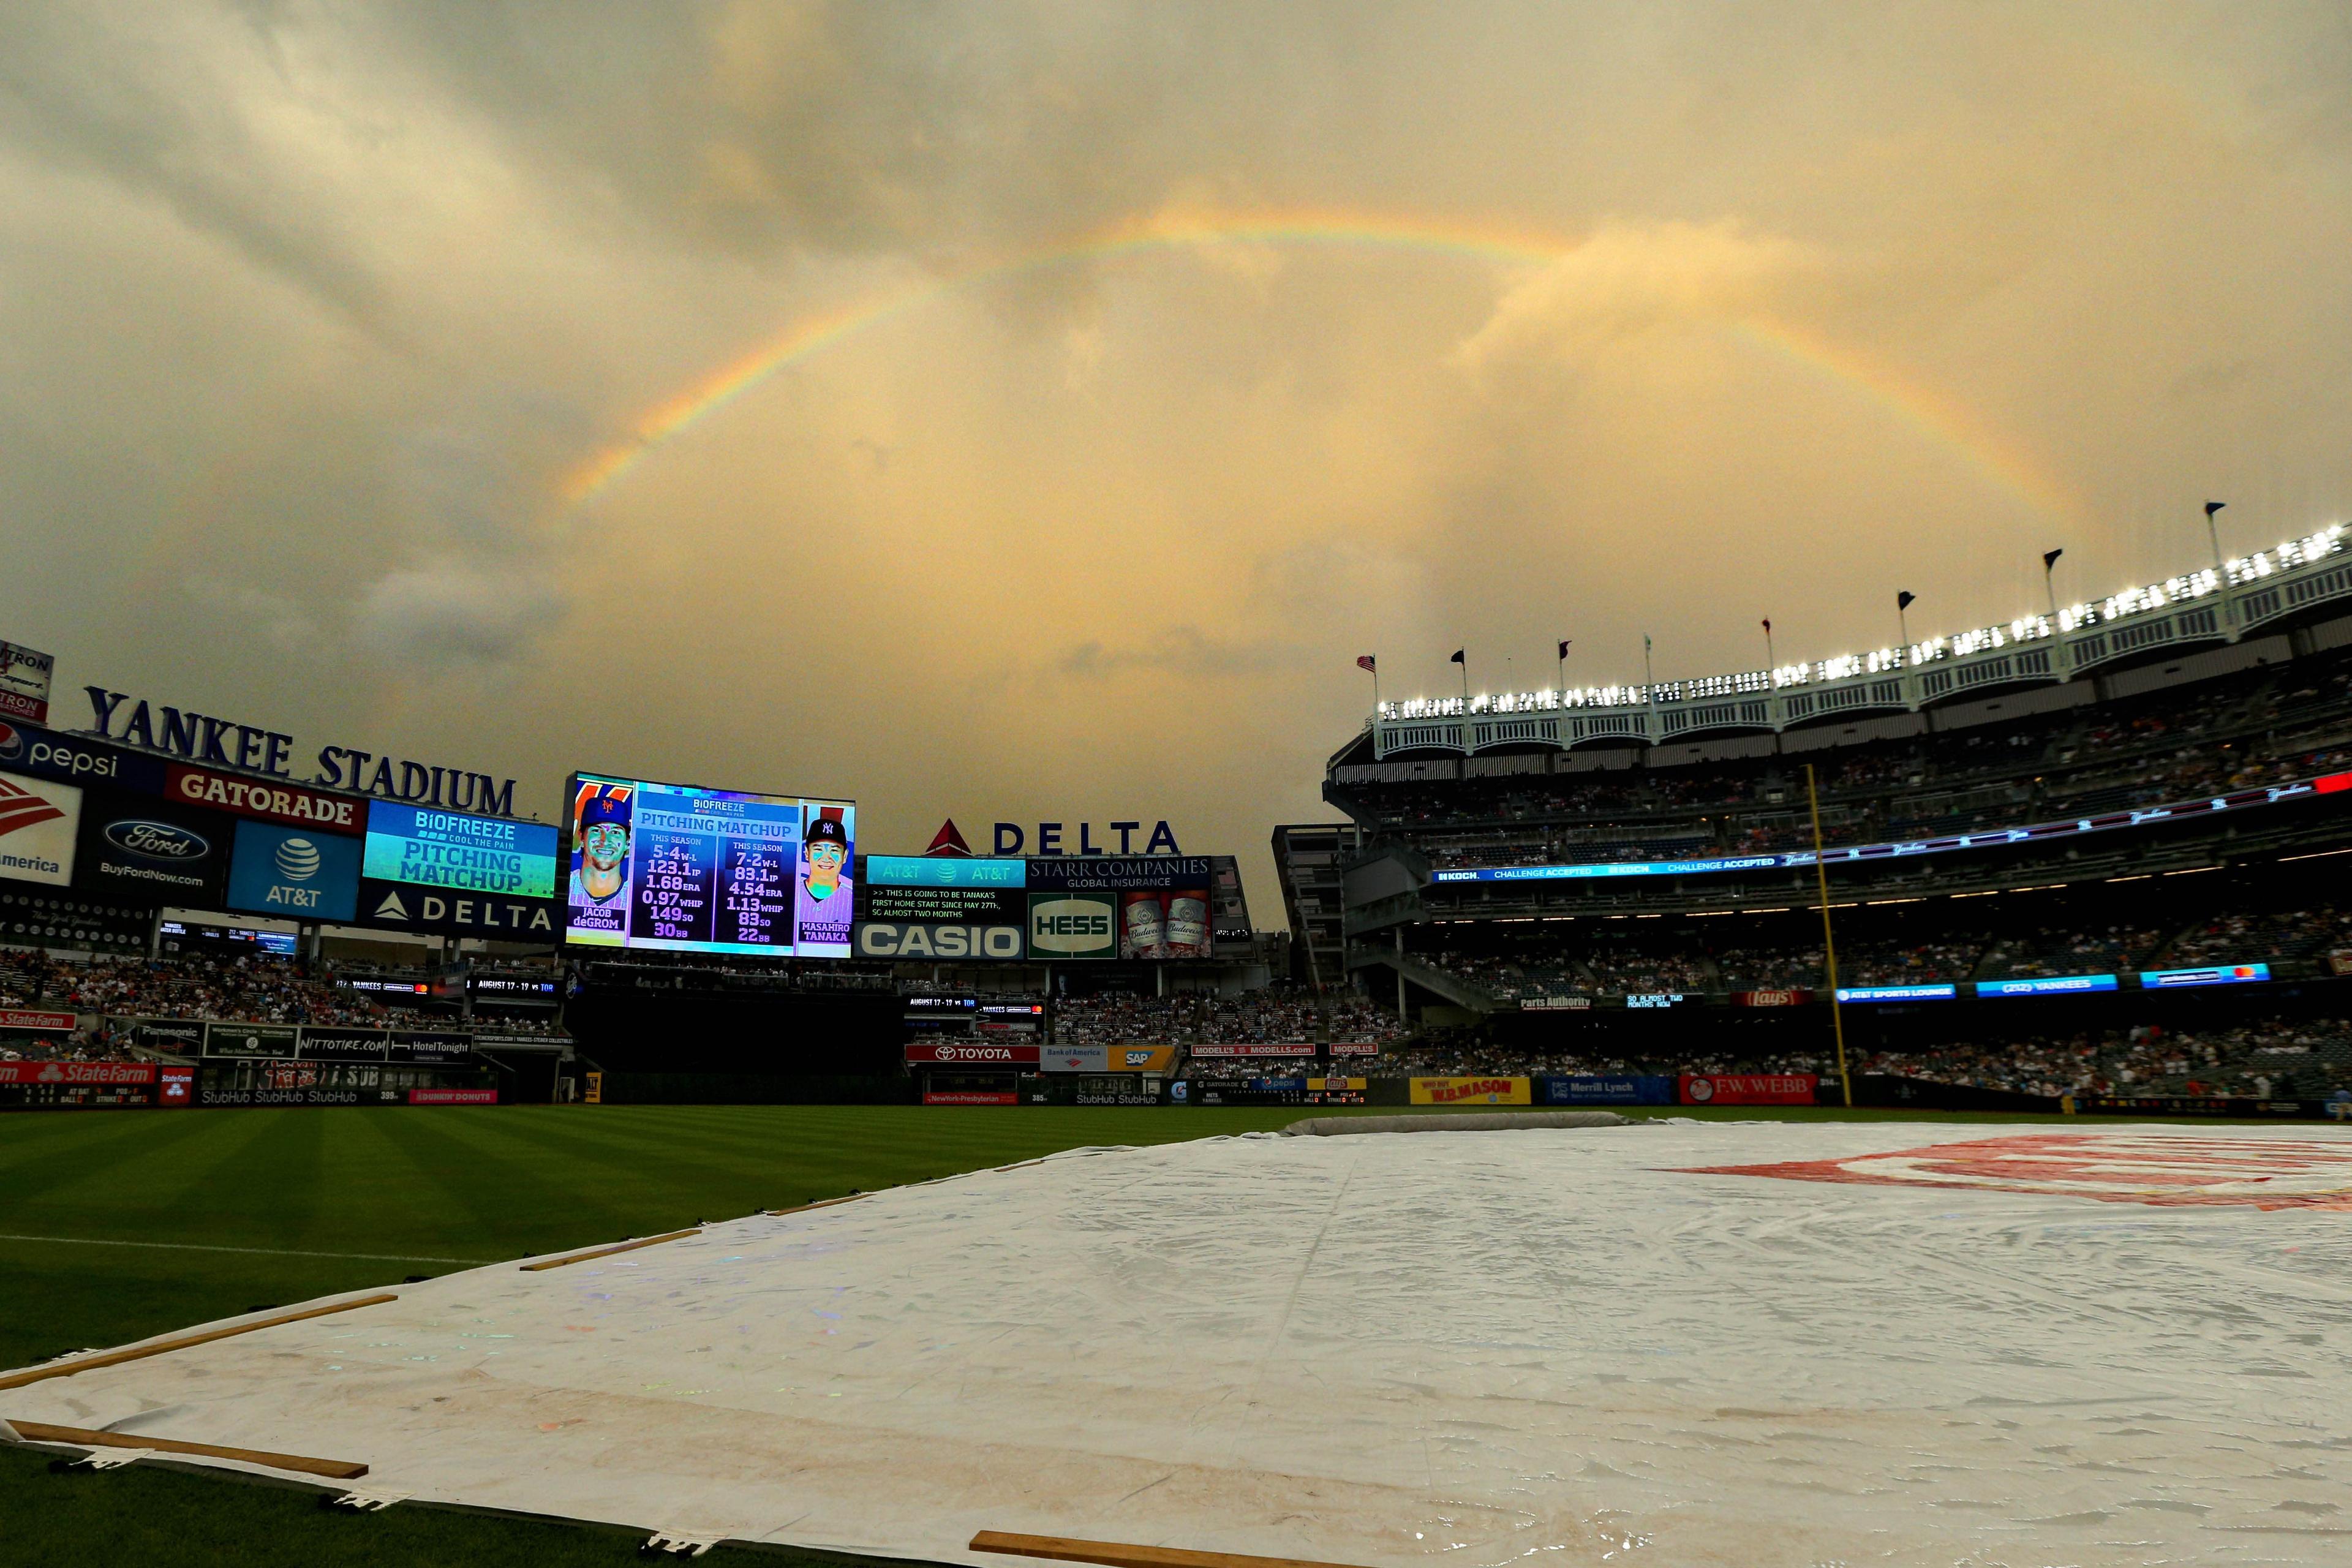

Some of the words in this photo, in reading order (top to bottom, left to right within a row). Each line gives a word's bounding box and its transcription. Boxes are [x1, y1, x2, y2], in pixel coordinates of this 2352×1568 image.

[83, 685, 293, 778] YANKEE
[318, 745, 516, 816] STADIUM
[29, 743, 118, 778] pepsi
[181, 774, 353, 826] GATORADE
[2266, 783, 2312, 802] Yankees
[641, 812, 714, 831] PITCHING
[718, 820, 791, 837] MATCHUP
[124, 824, 191, 856] Ford
[449, 835, 472, 845] COOL
[474, 838, 491, 847] THE
[494, 841, 514, 850] PAIN
[650, 834, 669, 843] THIS
[671, 835, 701, 846] SEASON
[993, 821, 1179, 855] DELTA
[653, 844, 680, 859] 5-4
[681, 853, 697, 862] W-L
[753, 844, 783, 853] SEASON
[1893, 842, 1927, 856] Yankees
[404, 840, 521, 873] PITCHING
[736, 851, 762, 866] 7-2
[763, 859, 778, 868] W-L
[100, 862, 203, 887] BuyFordNow.com
[647, 859, 692, 876] 123.1
[734, 866, 769, 882] 83.1
[883, 865, 921, 878] AT&T
[972, 867, 1010, 880] AT&T
[1031, 862, 1093, 877] STARR
[1096, 859, 1208, 876] COMPANIES
[1494, 870, 1545, 879] CHALLENGE
[1546, 867, 1592, 876] ACCEPTED
[1668, 861, 1722, 872] CHALLENGE
[1724, 858, 1775, 869] ACCEPTED
[399, 861, 522, 892] MATCHUP
[646, 875, 682, 891] 1.68
[683, 883, 701, 892] ERA
[1068, 879, 1108, 888] GLOBAL
[1111, 877, 1171, 887] INSURANCE
[729, 881, 765, 896] 4.54
[266, 886, 321, 907] AT&T
[642, 890, 680, 906] 0.97
[680, 899, 703, 908] WHIP
[726, 897, 760, 912] 1.13
[761, 904, 783, 913] WHIP
[422, 896, 552, 931] DELTA
[582, 908, 612, 918] JACOB
[650, 906, 682, 921] 149
[738, 911, 760, 926] 83
[573, 916, 619, 929] deGROM
[654, 922, 676, 937] 30
[802, 922, 850, 932] MASAHIRO
[1036, 916, 1108, 935] HESS
[738, 927, 758, 942] 22
[804, 932, 848, 941] TANAKA
[861, 924, 1020, 957] CASIO
[353, 981, 382, 990] YANKEES
[478, 980, 505, 990] AUGUST
[521, 982, 529, 991] 19
[540, 983, 554, 992] TOR
[1873, 990, 1910, 998] SPORTS
[1910, 988, 1953, 997] LOUNGE
[2035, 981, 2092, 991] YANKEES
[1520, 998, 1545, 1008] Parts
[1547, 996, 1591, 1006] Authority
[142, 1026, 198, 1037] Panasonic
[300, 1036, 386, 1052] NITTOTIRE.COM
[958, 1049, 1012, 1059] TOYOTA
[1126, 1054, 1149, 1064] SAP
[1273, 1079, 1295, 1088] pepsi
[1570, 1082, 1602, 1092] Merrill
[1605, 1082, 1634, 1093] Lynch
[1716, 1079, 1747, 1093] F.W.
[1751, 1078, 1807, 1093] WEBB
[202, 1091, 250, 1103] StubHub
[255, 1091, 303, 1102] StubHub
[308, 1090, 356, 1102] StubHub
[1077, 1095, 1115, 1104] StubHub
[1118, 1095, 1156, 1104] StubHub
